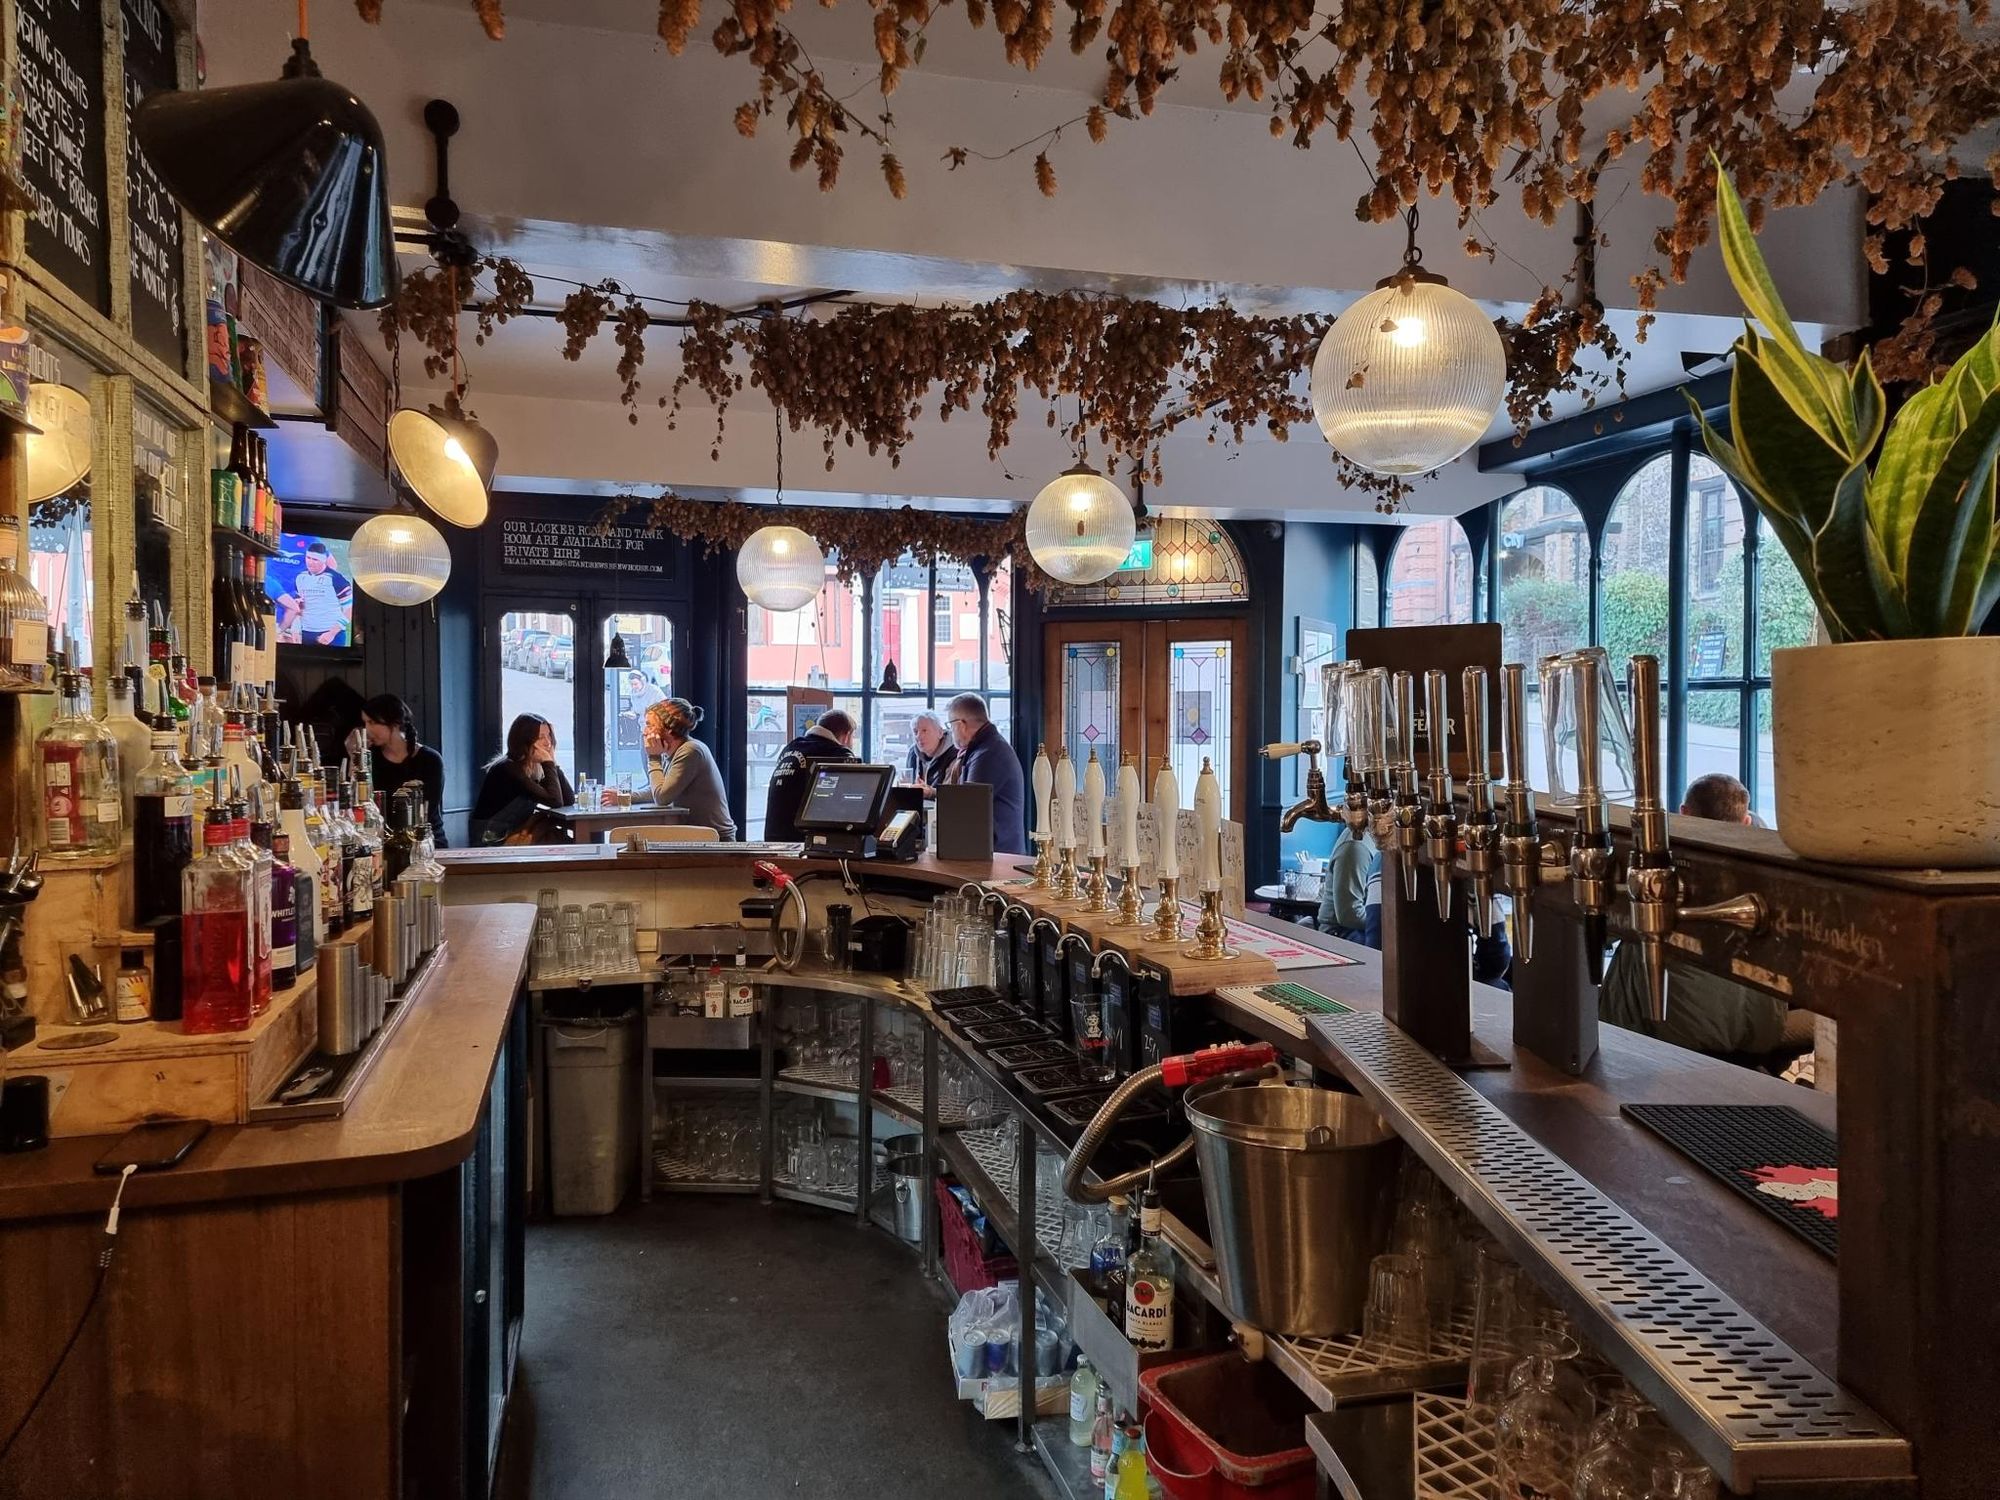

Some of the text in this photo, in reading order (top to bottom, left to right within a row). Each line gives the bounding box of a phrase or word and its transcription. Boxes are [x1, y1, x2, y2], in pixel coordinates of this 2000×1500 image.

[54, 47, 88, 109] FLIGHTS
[46, 78, 74, 134] BITES
[48, 147, 66, 191] THE
[69, 169, 99, 229] BREWER
[60, 211, 91, 266] TOURS
[503, 520, 527, 532] OUR
[530, 522, 576, 535] LOCKER
[503, 533, 644, 550] ROOM ARE AVAILABLE FOR
[504, 545, 581, 559] PRIVATE HIRE
